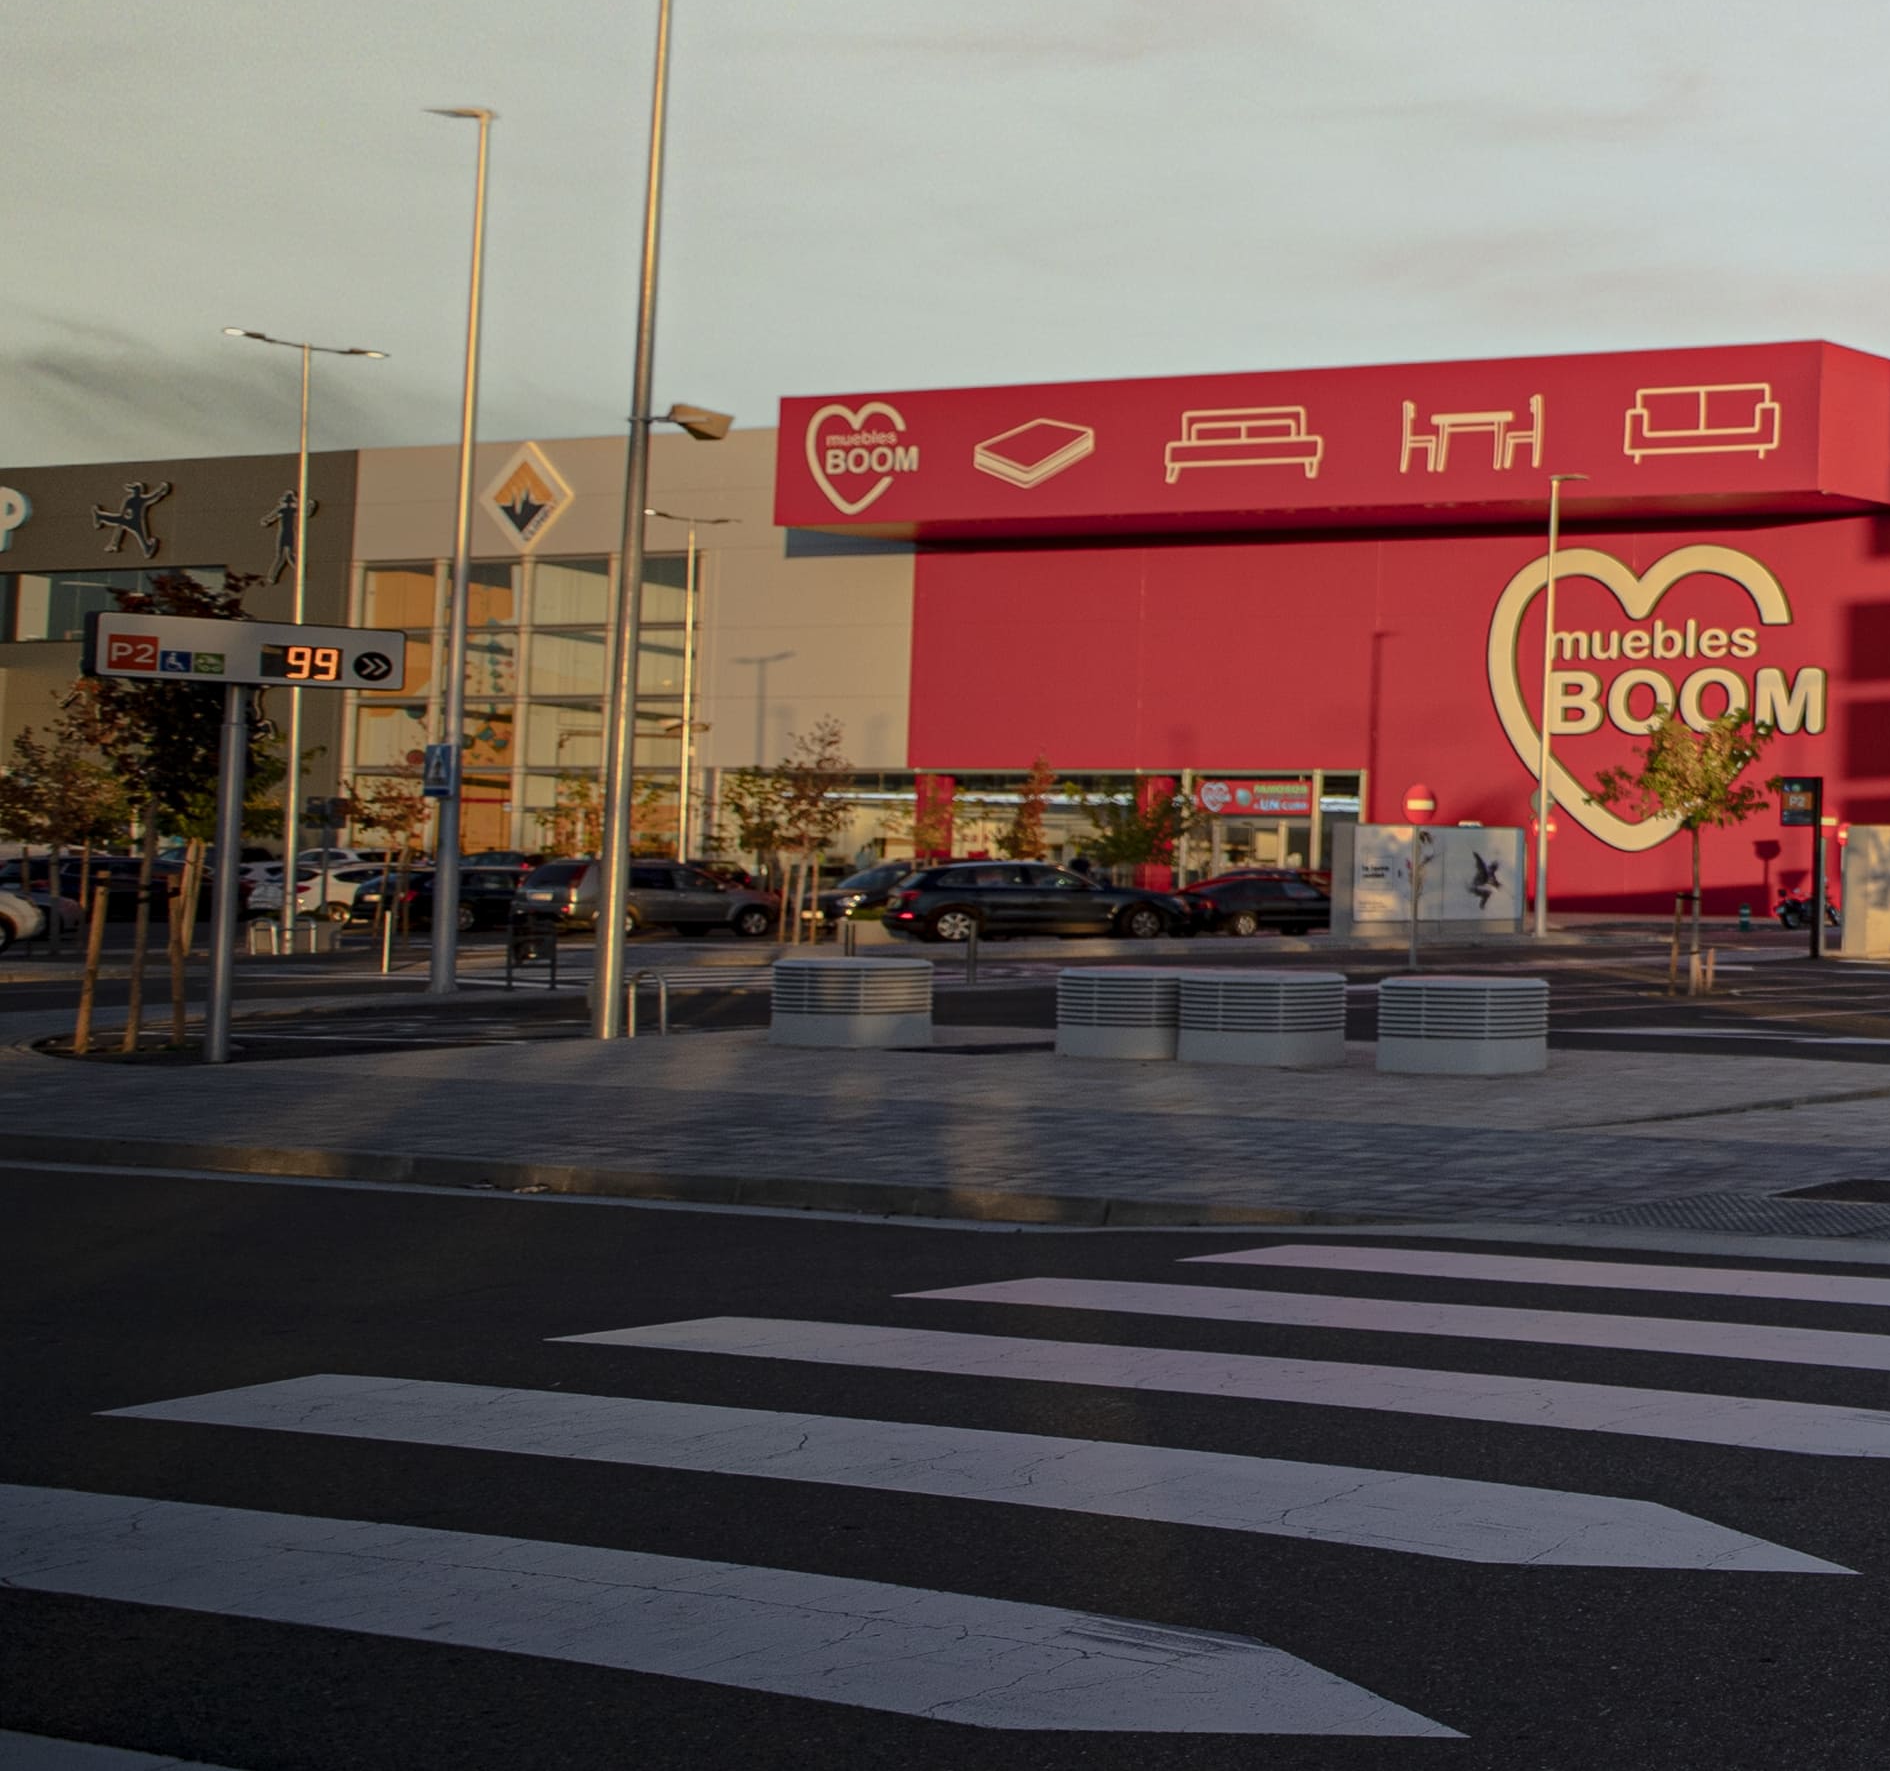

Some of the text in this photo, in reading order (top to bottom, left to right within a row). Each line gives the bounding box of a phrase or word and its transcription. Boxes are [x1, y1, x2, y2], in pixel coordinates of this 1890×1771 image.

[826, 430, 897, 447] muebles
[825, 445, 919, 475] BOOM
[110, 642, 155, 664] P2
[1551, 619, 1759, 660] muebles
[286, 646, 339, 681] 99
[1548, 666, 1827, 735] BOOM
